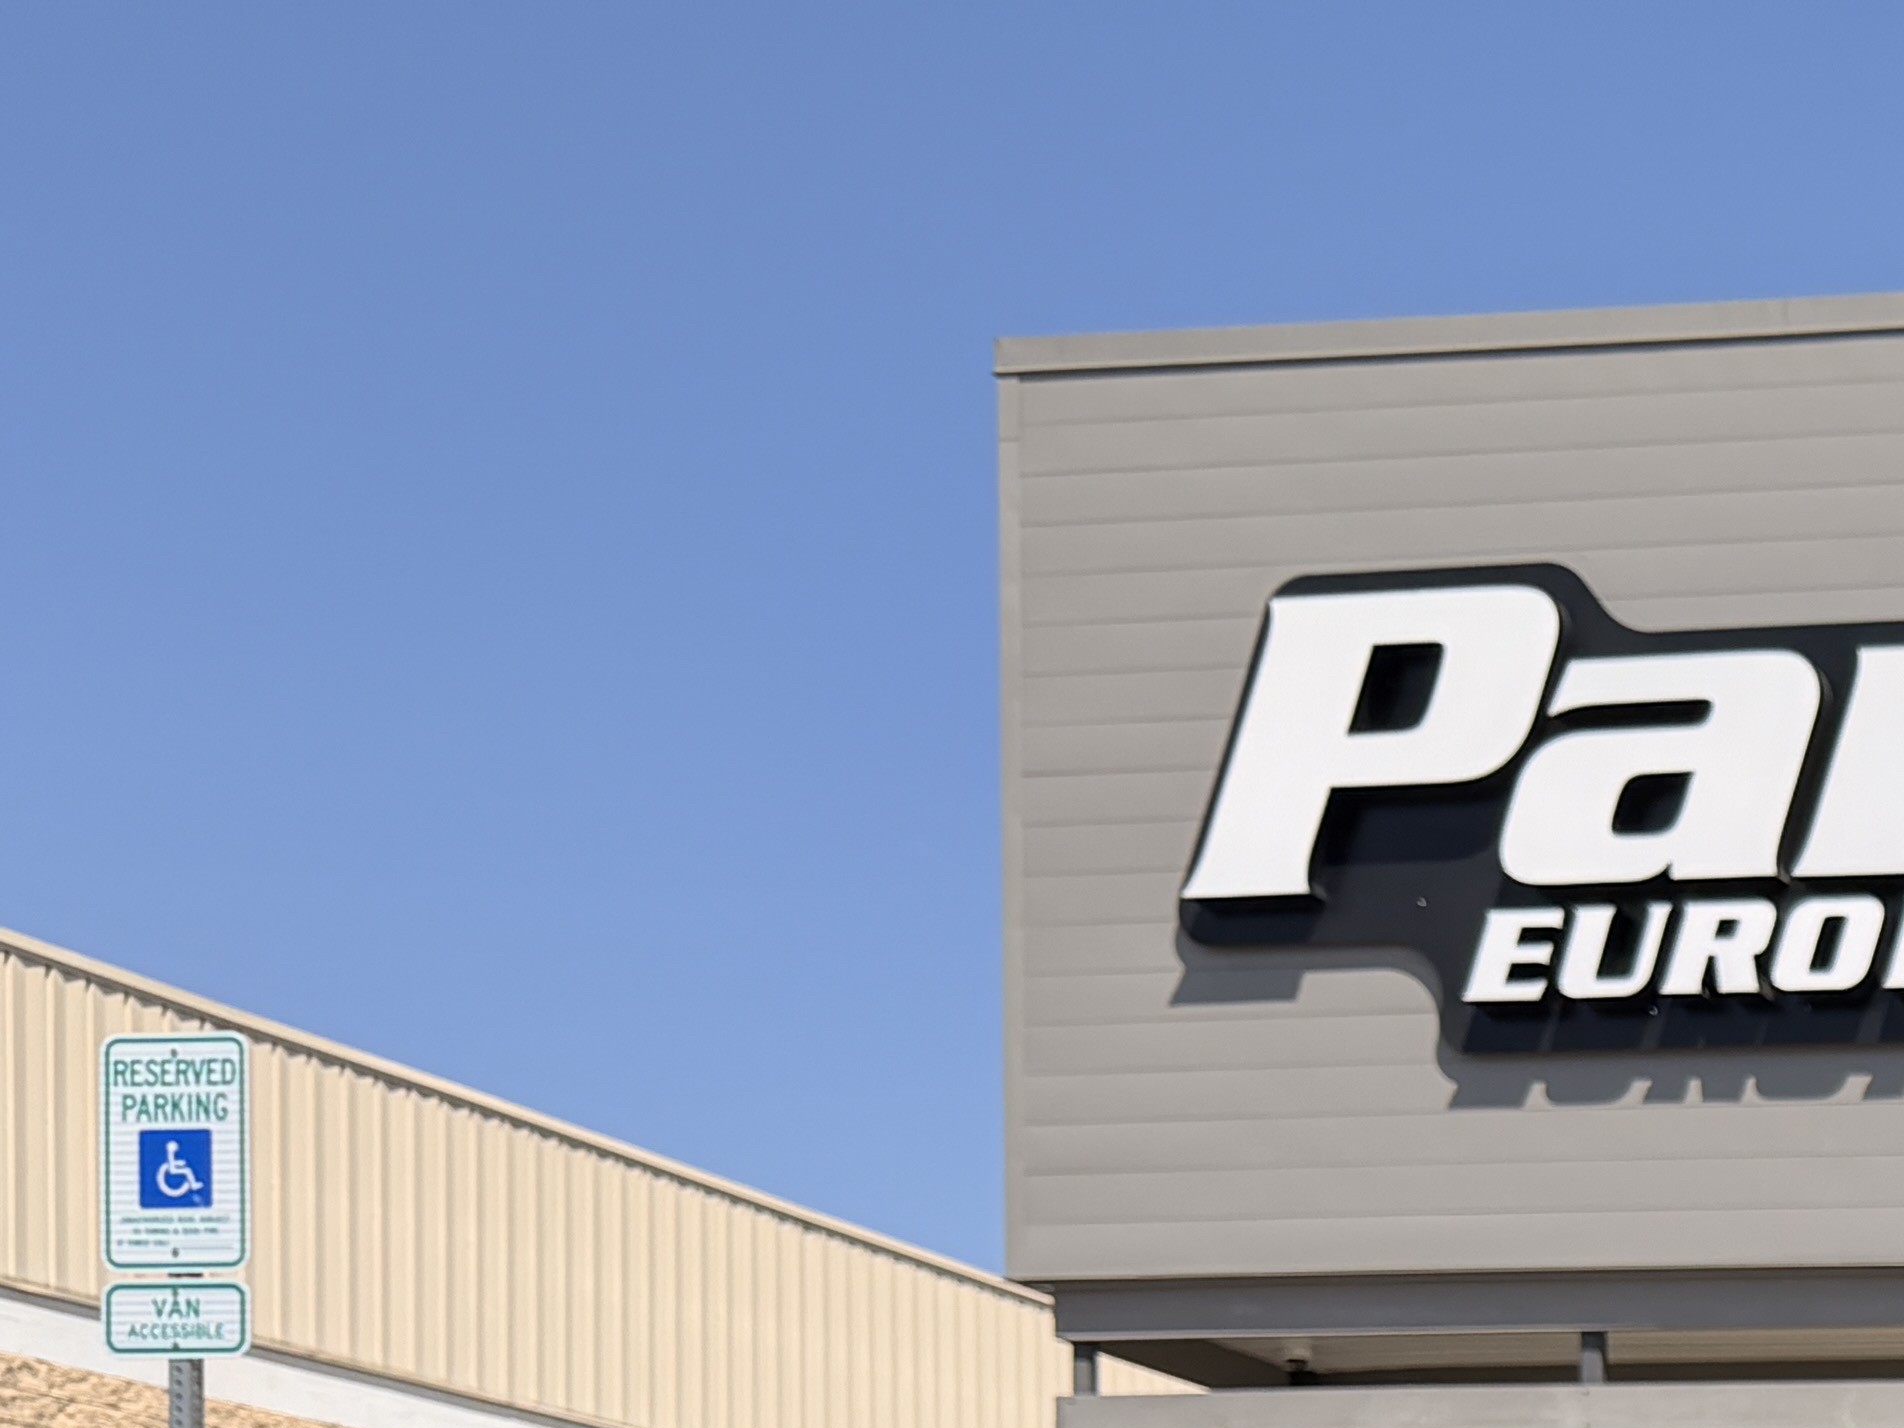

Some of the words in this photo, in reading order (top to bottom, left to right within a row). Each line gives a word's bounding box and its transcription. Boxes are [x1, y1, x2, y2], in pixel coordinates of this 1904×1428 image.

[113, 1058, 236, 1087] RESERVED
[122, 1093, 229, 1123] PARKING
[151, 1297, 201, 1319] VAN
[127, 1321, 226, 1341] ACCESSIBLE
